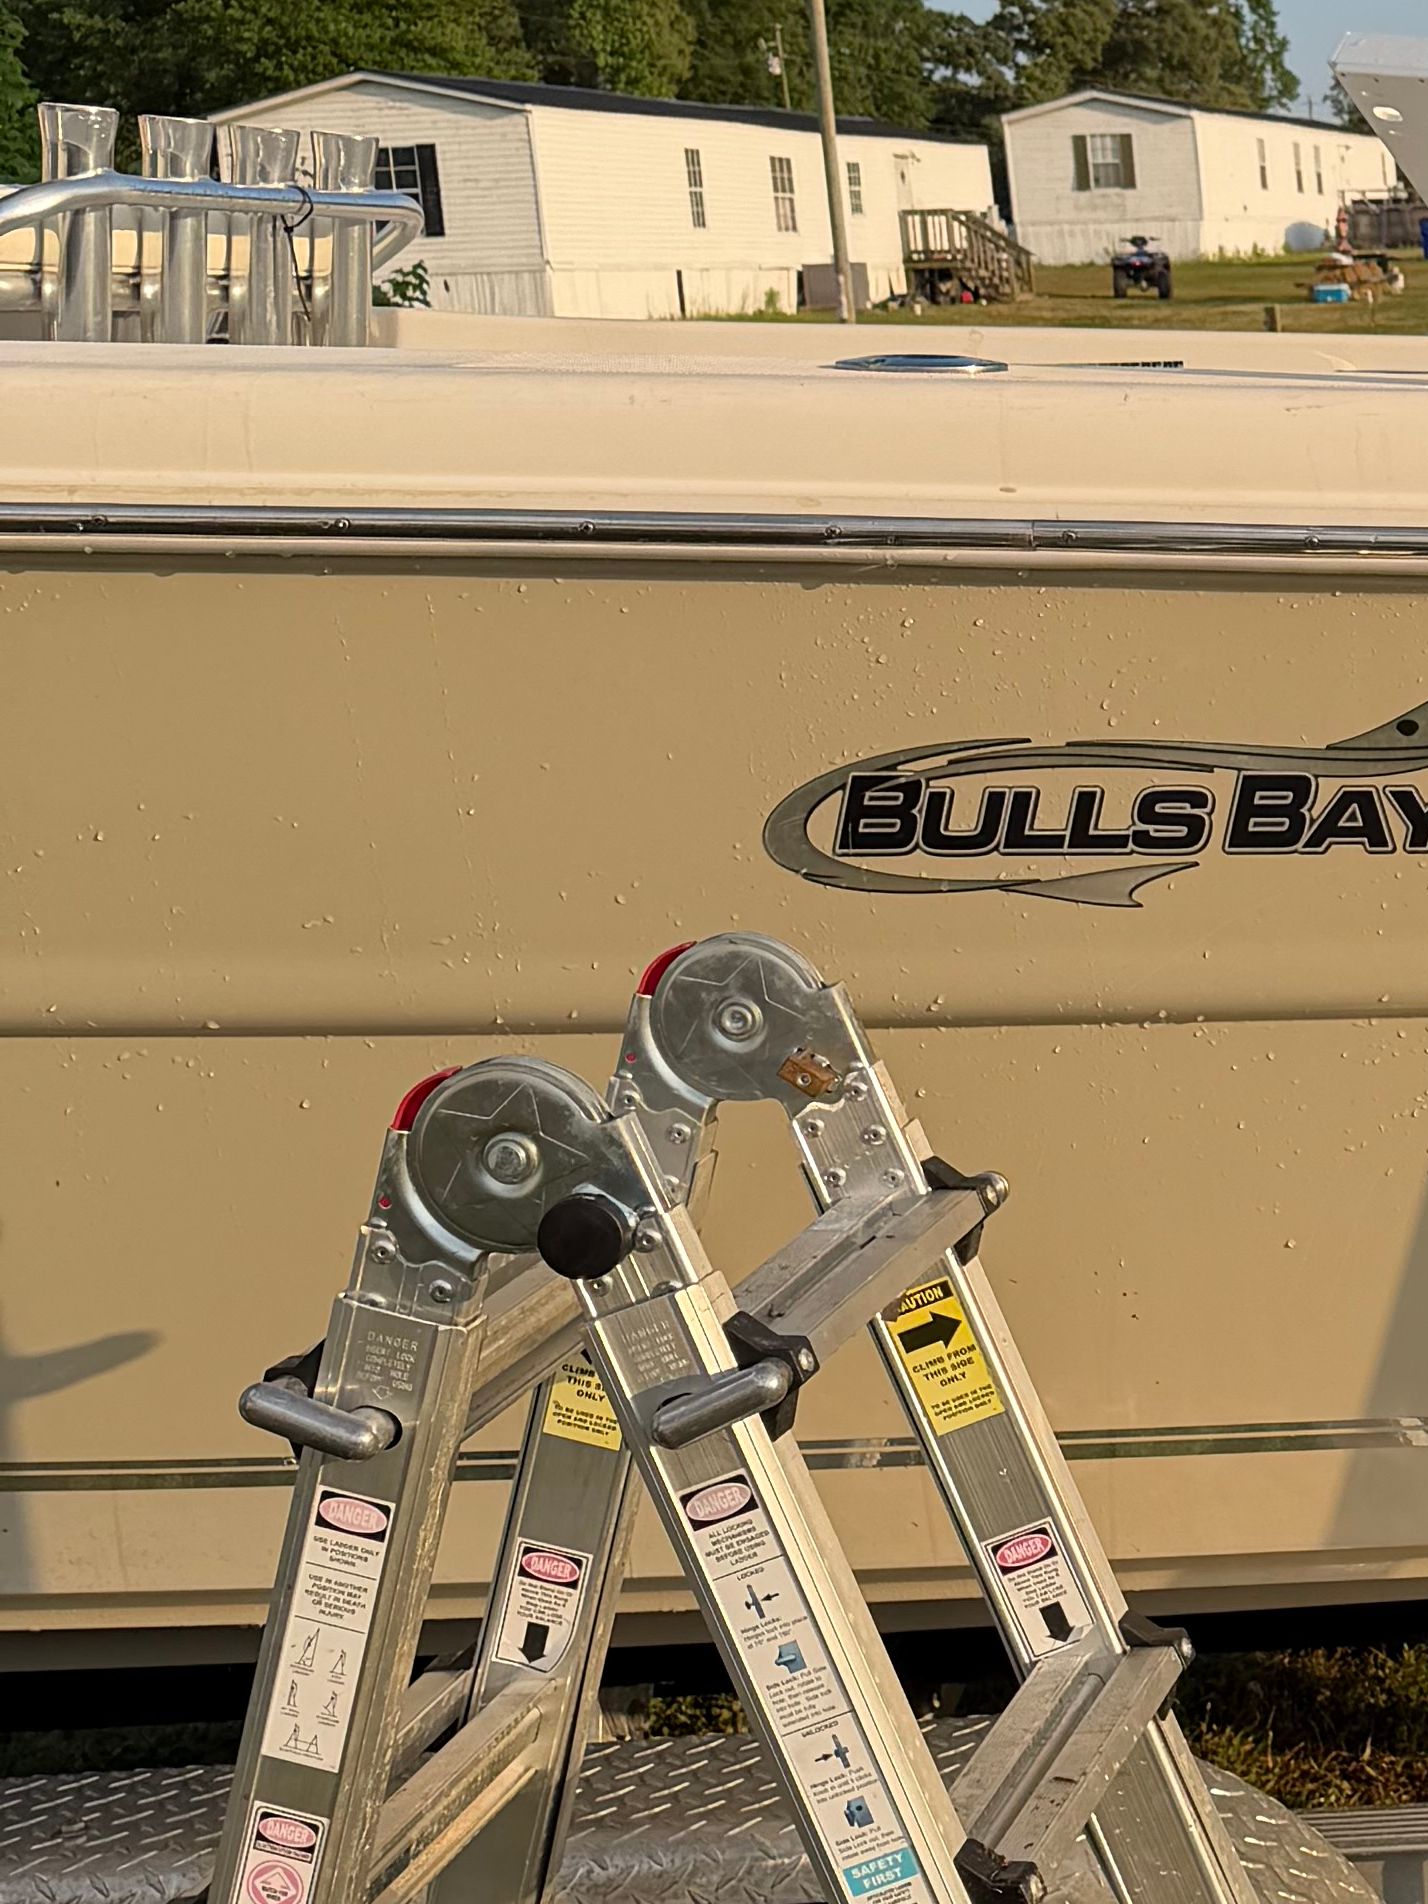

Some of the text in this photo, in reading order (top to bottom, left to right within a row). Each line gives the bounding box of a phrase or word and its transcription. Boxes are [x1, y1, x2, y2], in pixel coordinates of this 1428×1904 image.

[833, 770, 1216, 856] BULLS
[897, 1287, 942, 1311] AUTION
[367, 1331, 417, 1350] DANGER
[912, 1343, 976, 1372] CLIMB FROM
[923, 1357, 974, 1380] THIS SIDE
[561, 1362, 595, 1377] CLIMB
[940, 1372, 967, 1386] ONLY
[566, 1375, 591, 1388] THIS
[576, 1388, 605, 1402] ONLY
[694, 1486, 742, 1516] DANGER
[327, 1501, 378, 1529] DANGER
[1003, 1538, 1044, 1562] DANGER
[530, 1555, 571, 1578] DANGER
[265, 1820, 309, 1844] DANGER
[850, 1853, 904, 1878] SAFETY
[862, 1867, 903, 1888] FIRST
